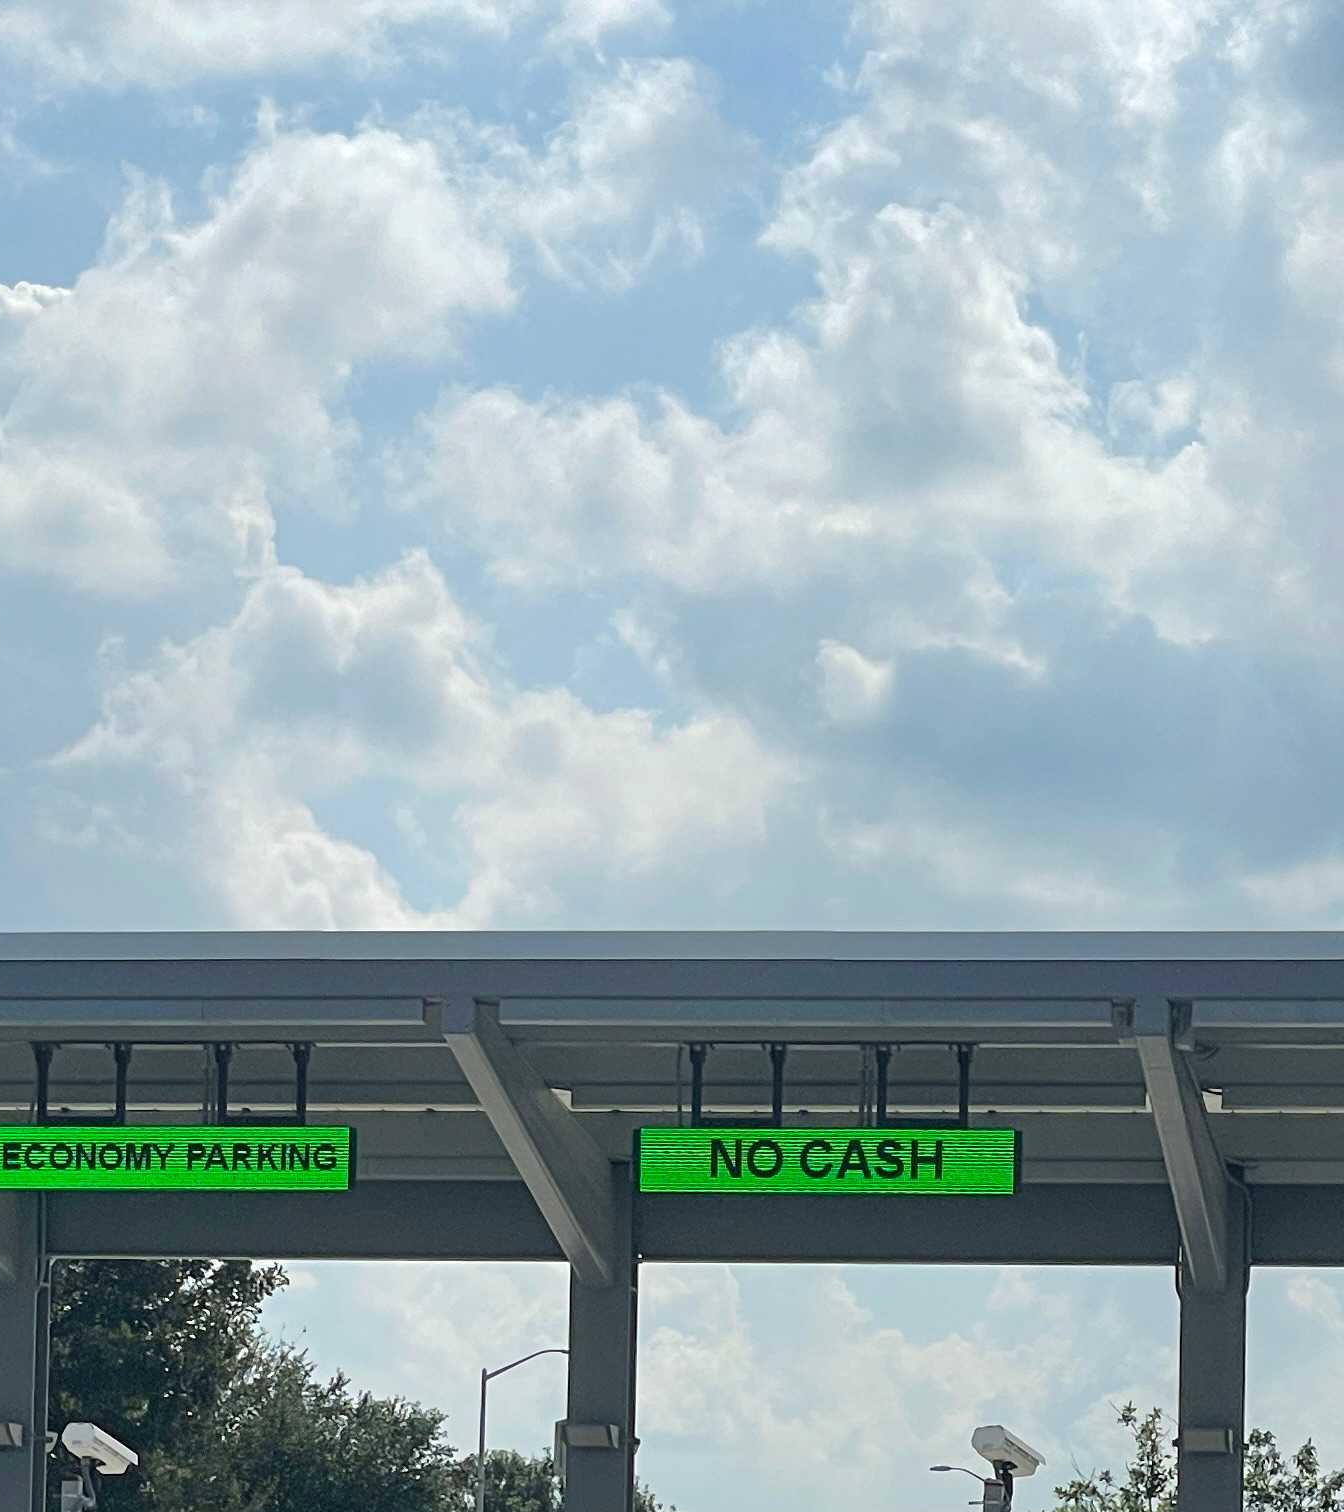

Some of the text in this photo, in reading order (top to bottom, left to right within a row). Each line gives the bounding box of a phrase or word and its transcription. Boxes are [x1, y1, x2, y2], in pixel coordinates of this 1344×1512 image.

[2, 1142, 338, 1171] ECONOMY PARKING
[709, 1138, 945, 1180] NO CASH
